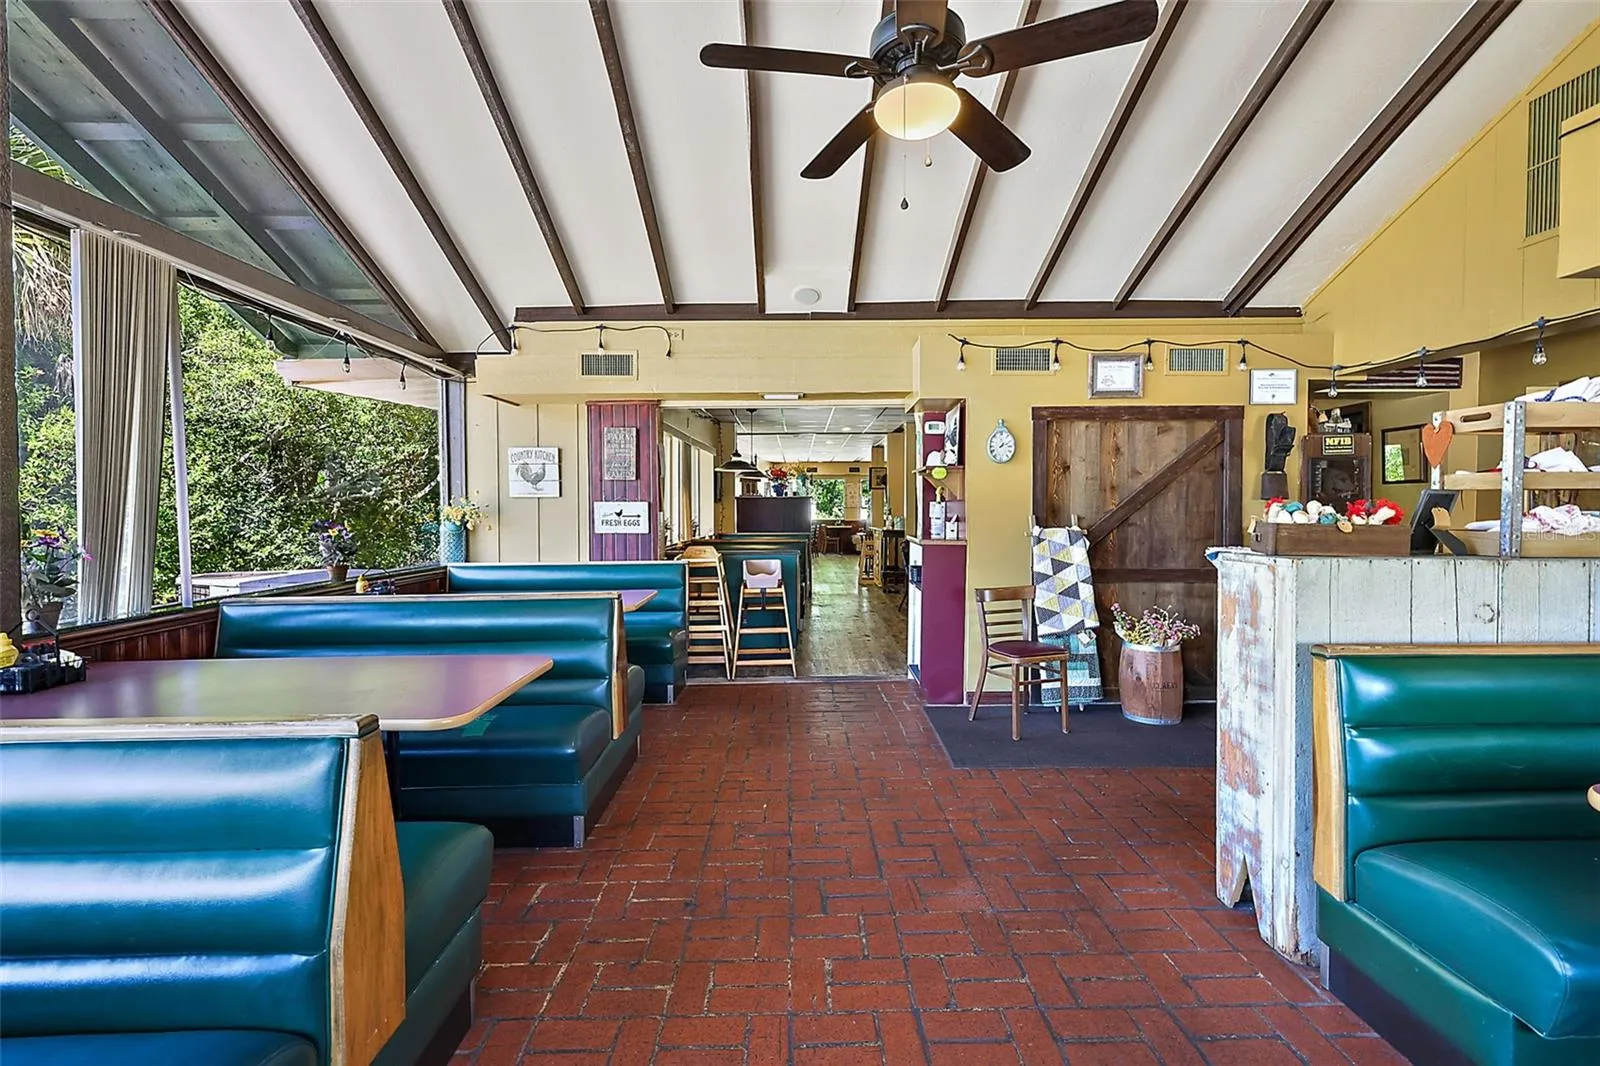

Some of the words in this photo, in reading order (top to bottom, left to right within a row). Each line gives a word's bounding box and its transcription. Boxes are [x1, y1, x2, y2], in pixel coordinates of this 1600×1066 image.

[511, 449, 533, 463] COUNTRY
[534, 449, 556, 463] KITCHEN
[601, 519, 622, 527] FRESH
[623, 519, 641, 527] EGGS
